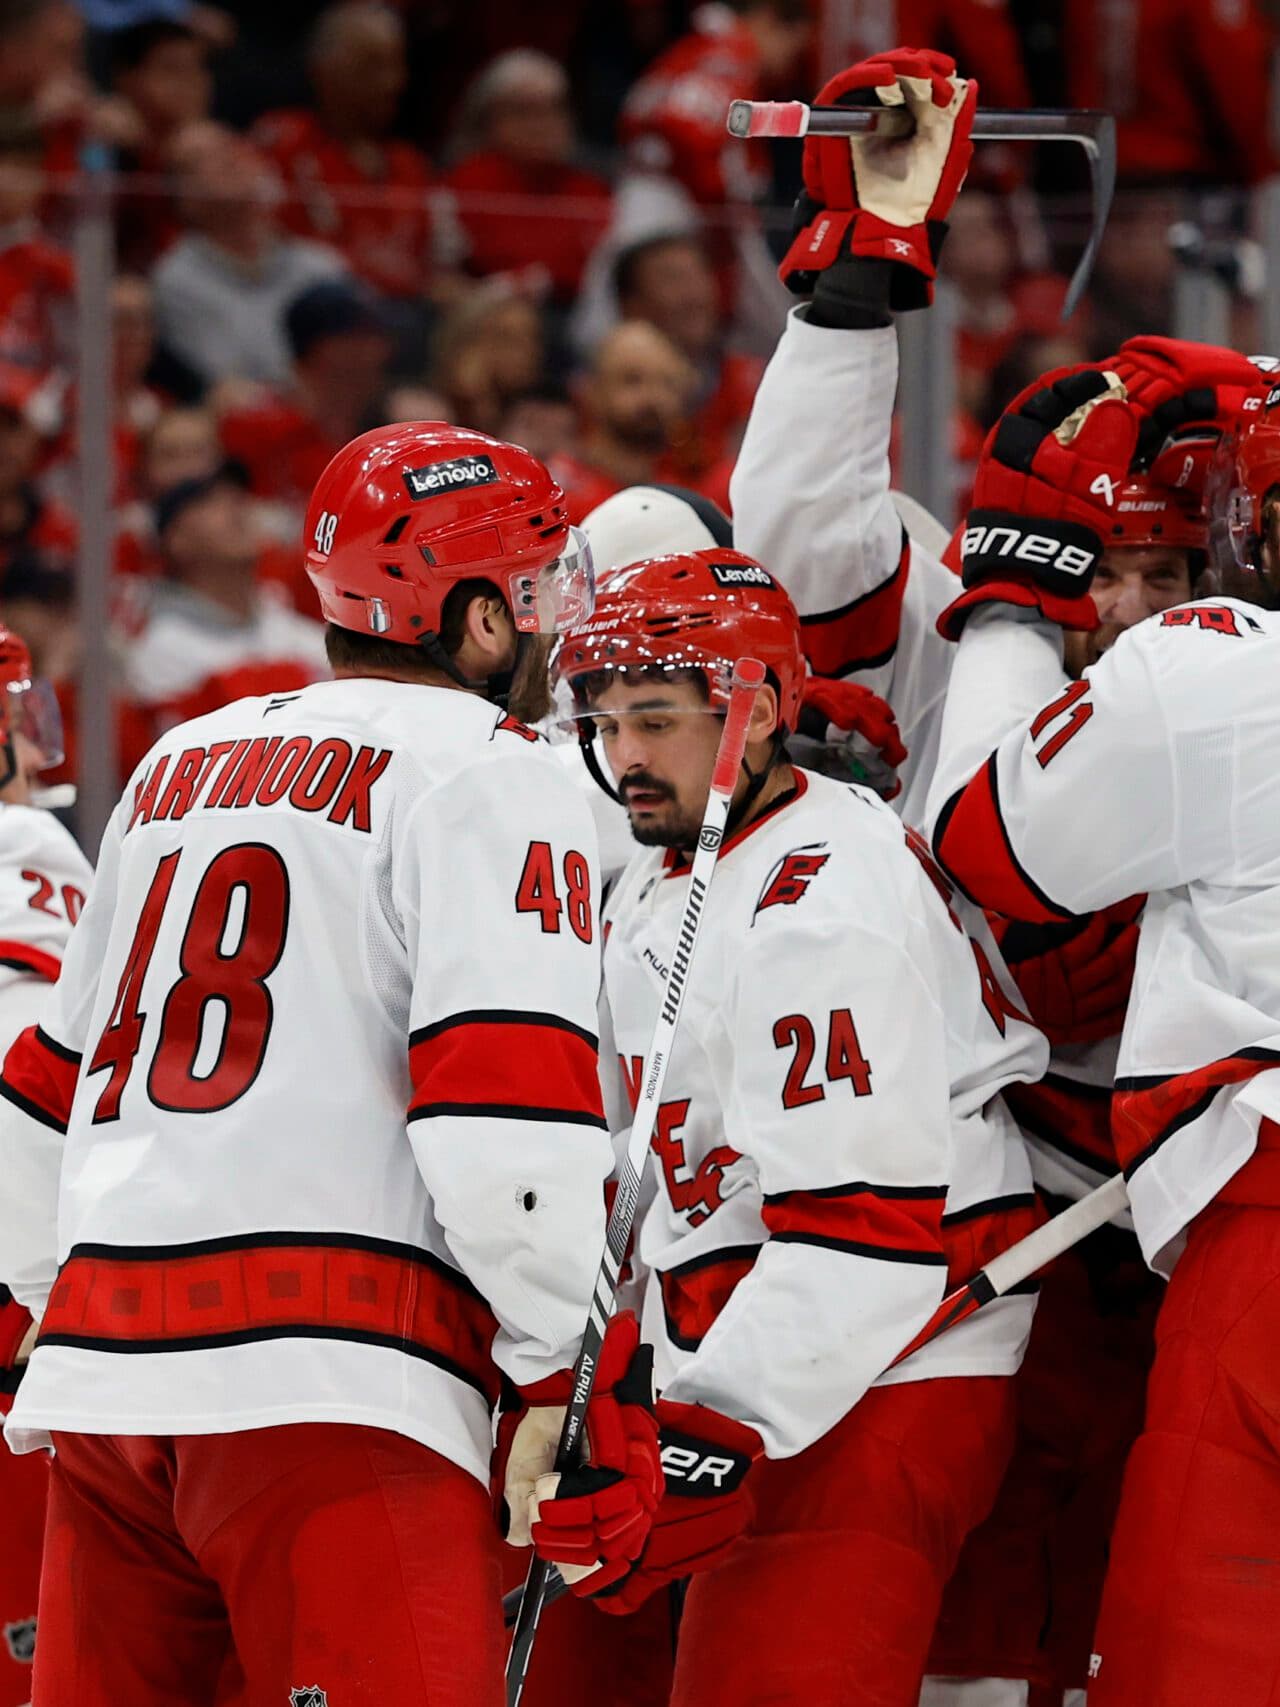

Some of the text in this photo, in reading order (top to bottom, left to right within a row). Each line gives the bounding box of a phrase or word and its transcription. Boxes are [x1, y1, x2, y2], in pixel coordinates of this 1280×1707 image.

[410, 462, 491, 493] Lenovo
[314, 511, 338, 556] 48
[961, 526, 1095, 577] BAUE
[714, 566, 772, 585] Lenovo
[1030, 679, 1095, 770] 11
[21, 869, 87, 928] 20
[515, 840, 594, 944] 48
[661, 876, 706, 1027] WARRIOR
[87, 842, 291, 1125] 48
[645, 1050, 664, 1101] MARTINOOK
[772, 1008, 873, 1110] 24
[573, 1353, 595, 1404] ALPHA
